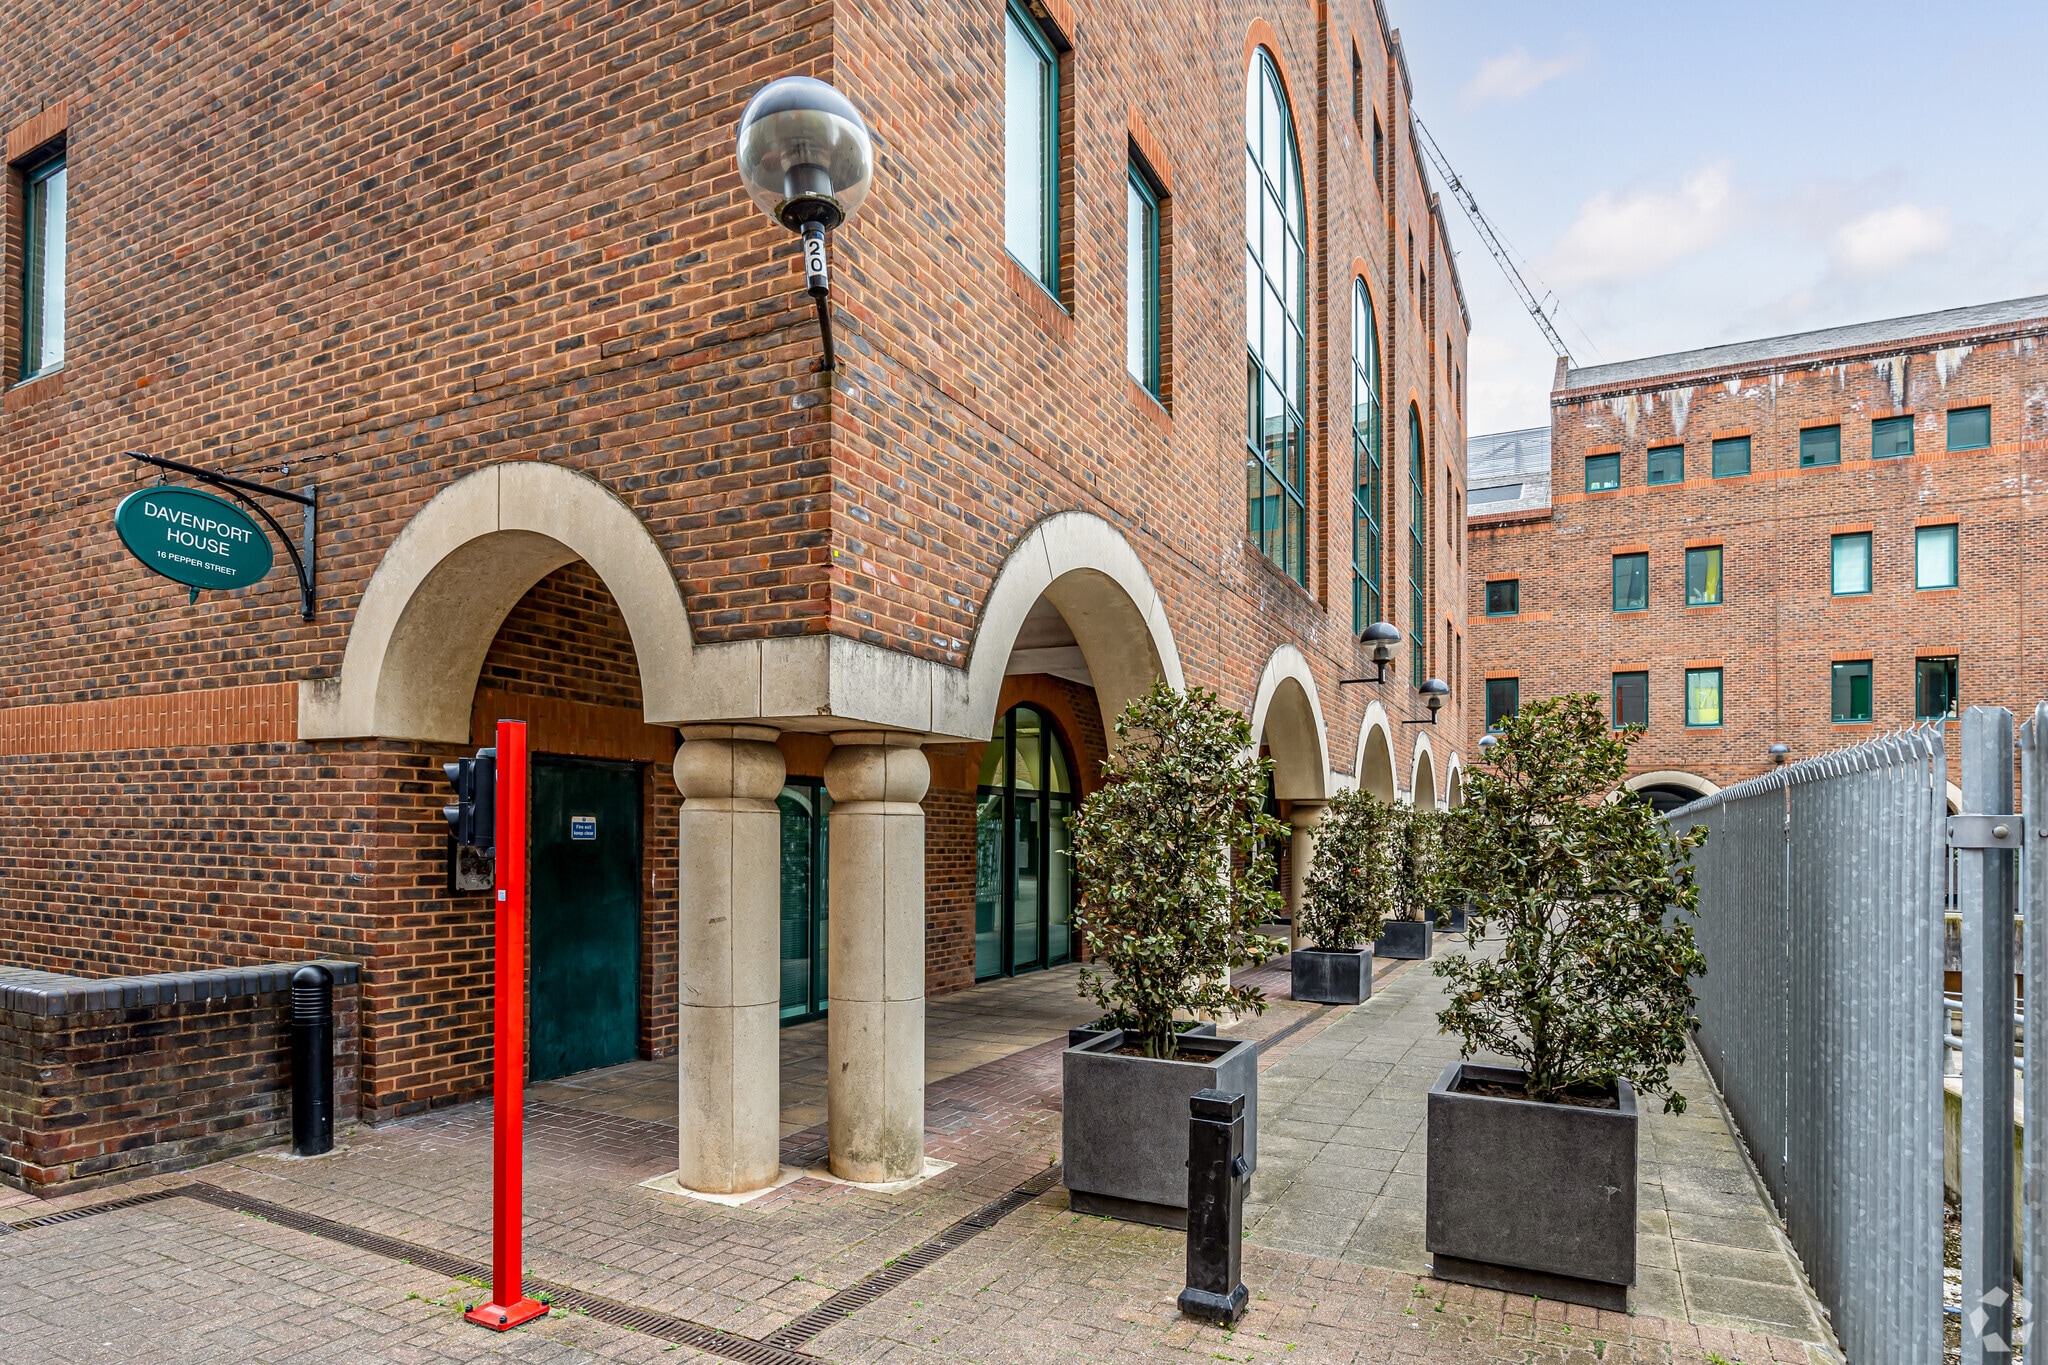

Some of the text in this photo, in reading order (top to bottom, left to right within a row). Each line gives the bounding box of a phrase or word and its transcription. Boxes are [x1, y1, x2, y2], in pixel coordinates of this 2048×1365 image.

[144, 502, 252, 543] DAVENPORT
[167, 528, 230, 557] HOUSE
[156, 550, 237, 576] 16 PEPPER STREET
